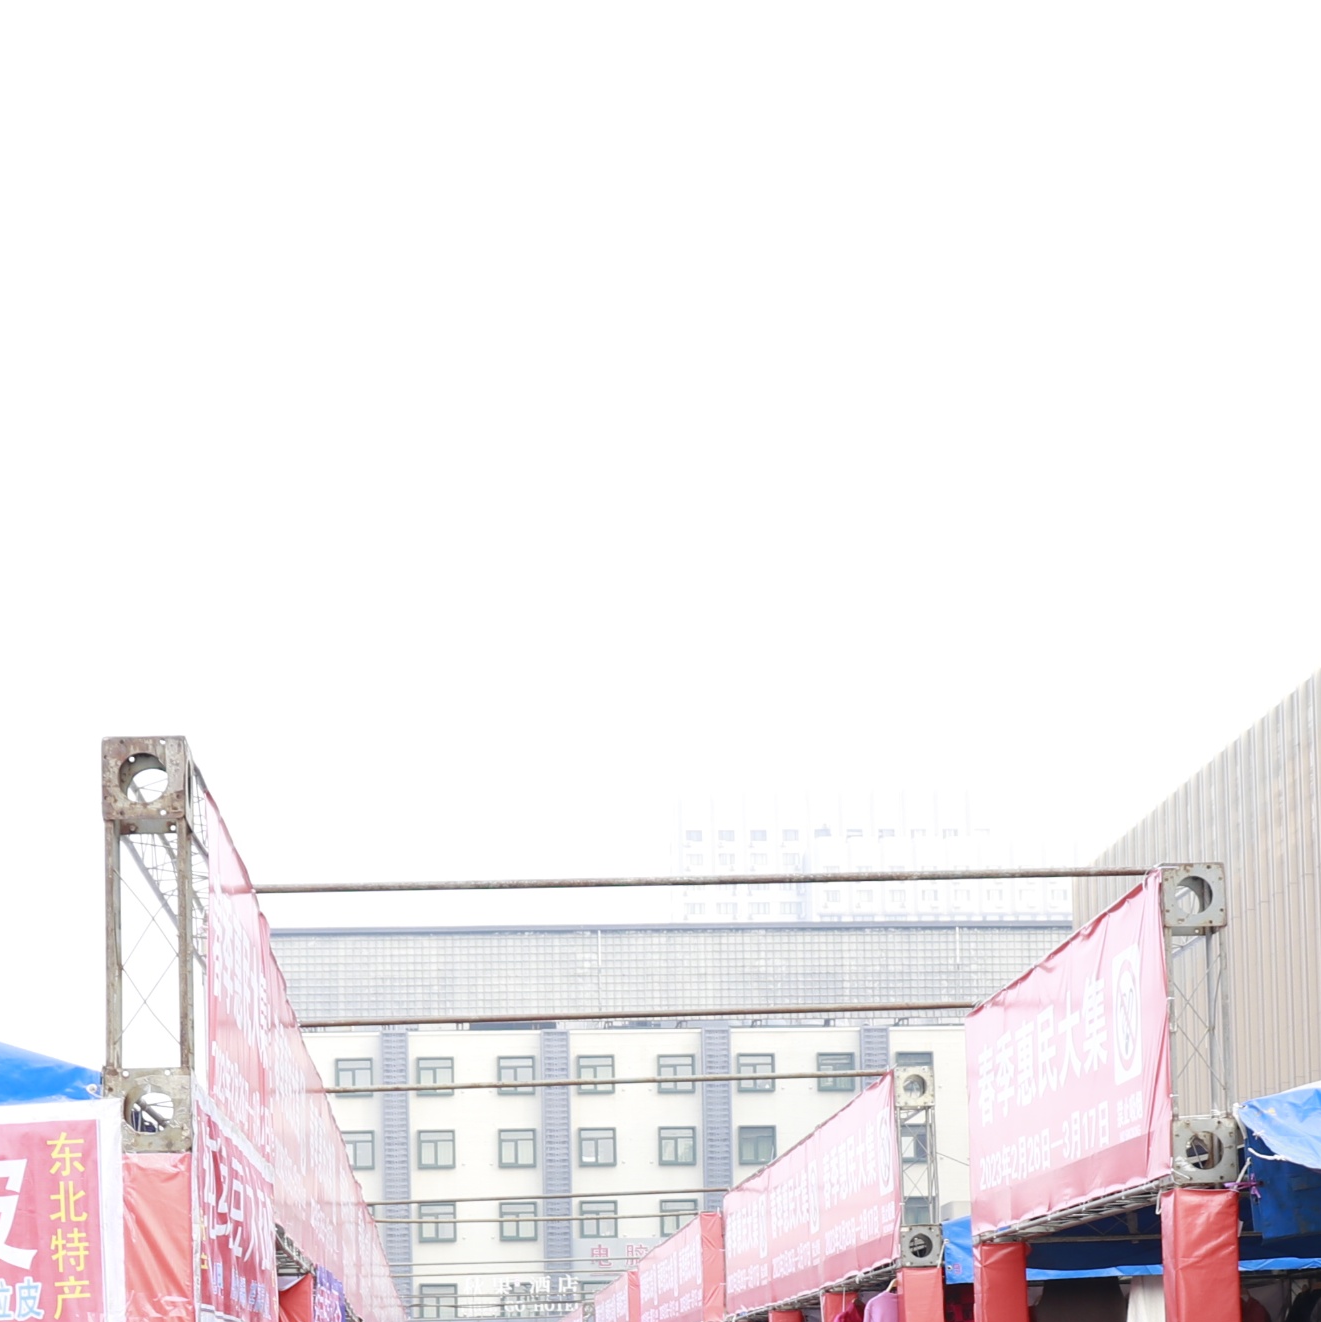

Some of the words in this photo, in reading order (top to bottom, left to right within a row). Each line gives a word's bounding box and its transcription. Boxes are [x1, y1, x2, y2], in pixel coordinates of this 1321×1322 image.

[978, 975, 1109, 1128] 春季惠民大集
[46, 1131, 91, 1321] 东北特产
[823, 1119, 877, 1210] 春季惠民大集
